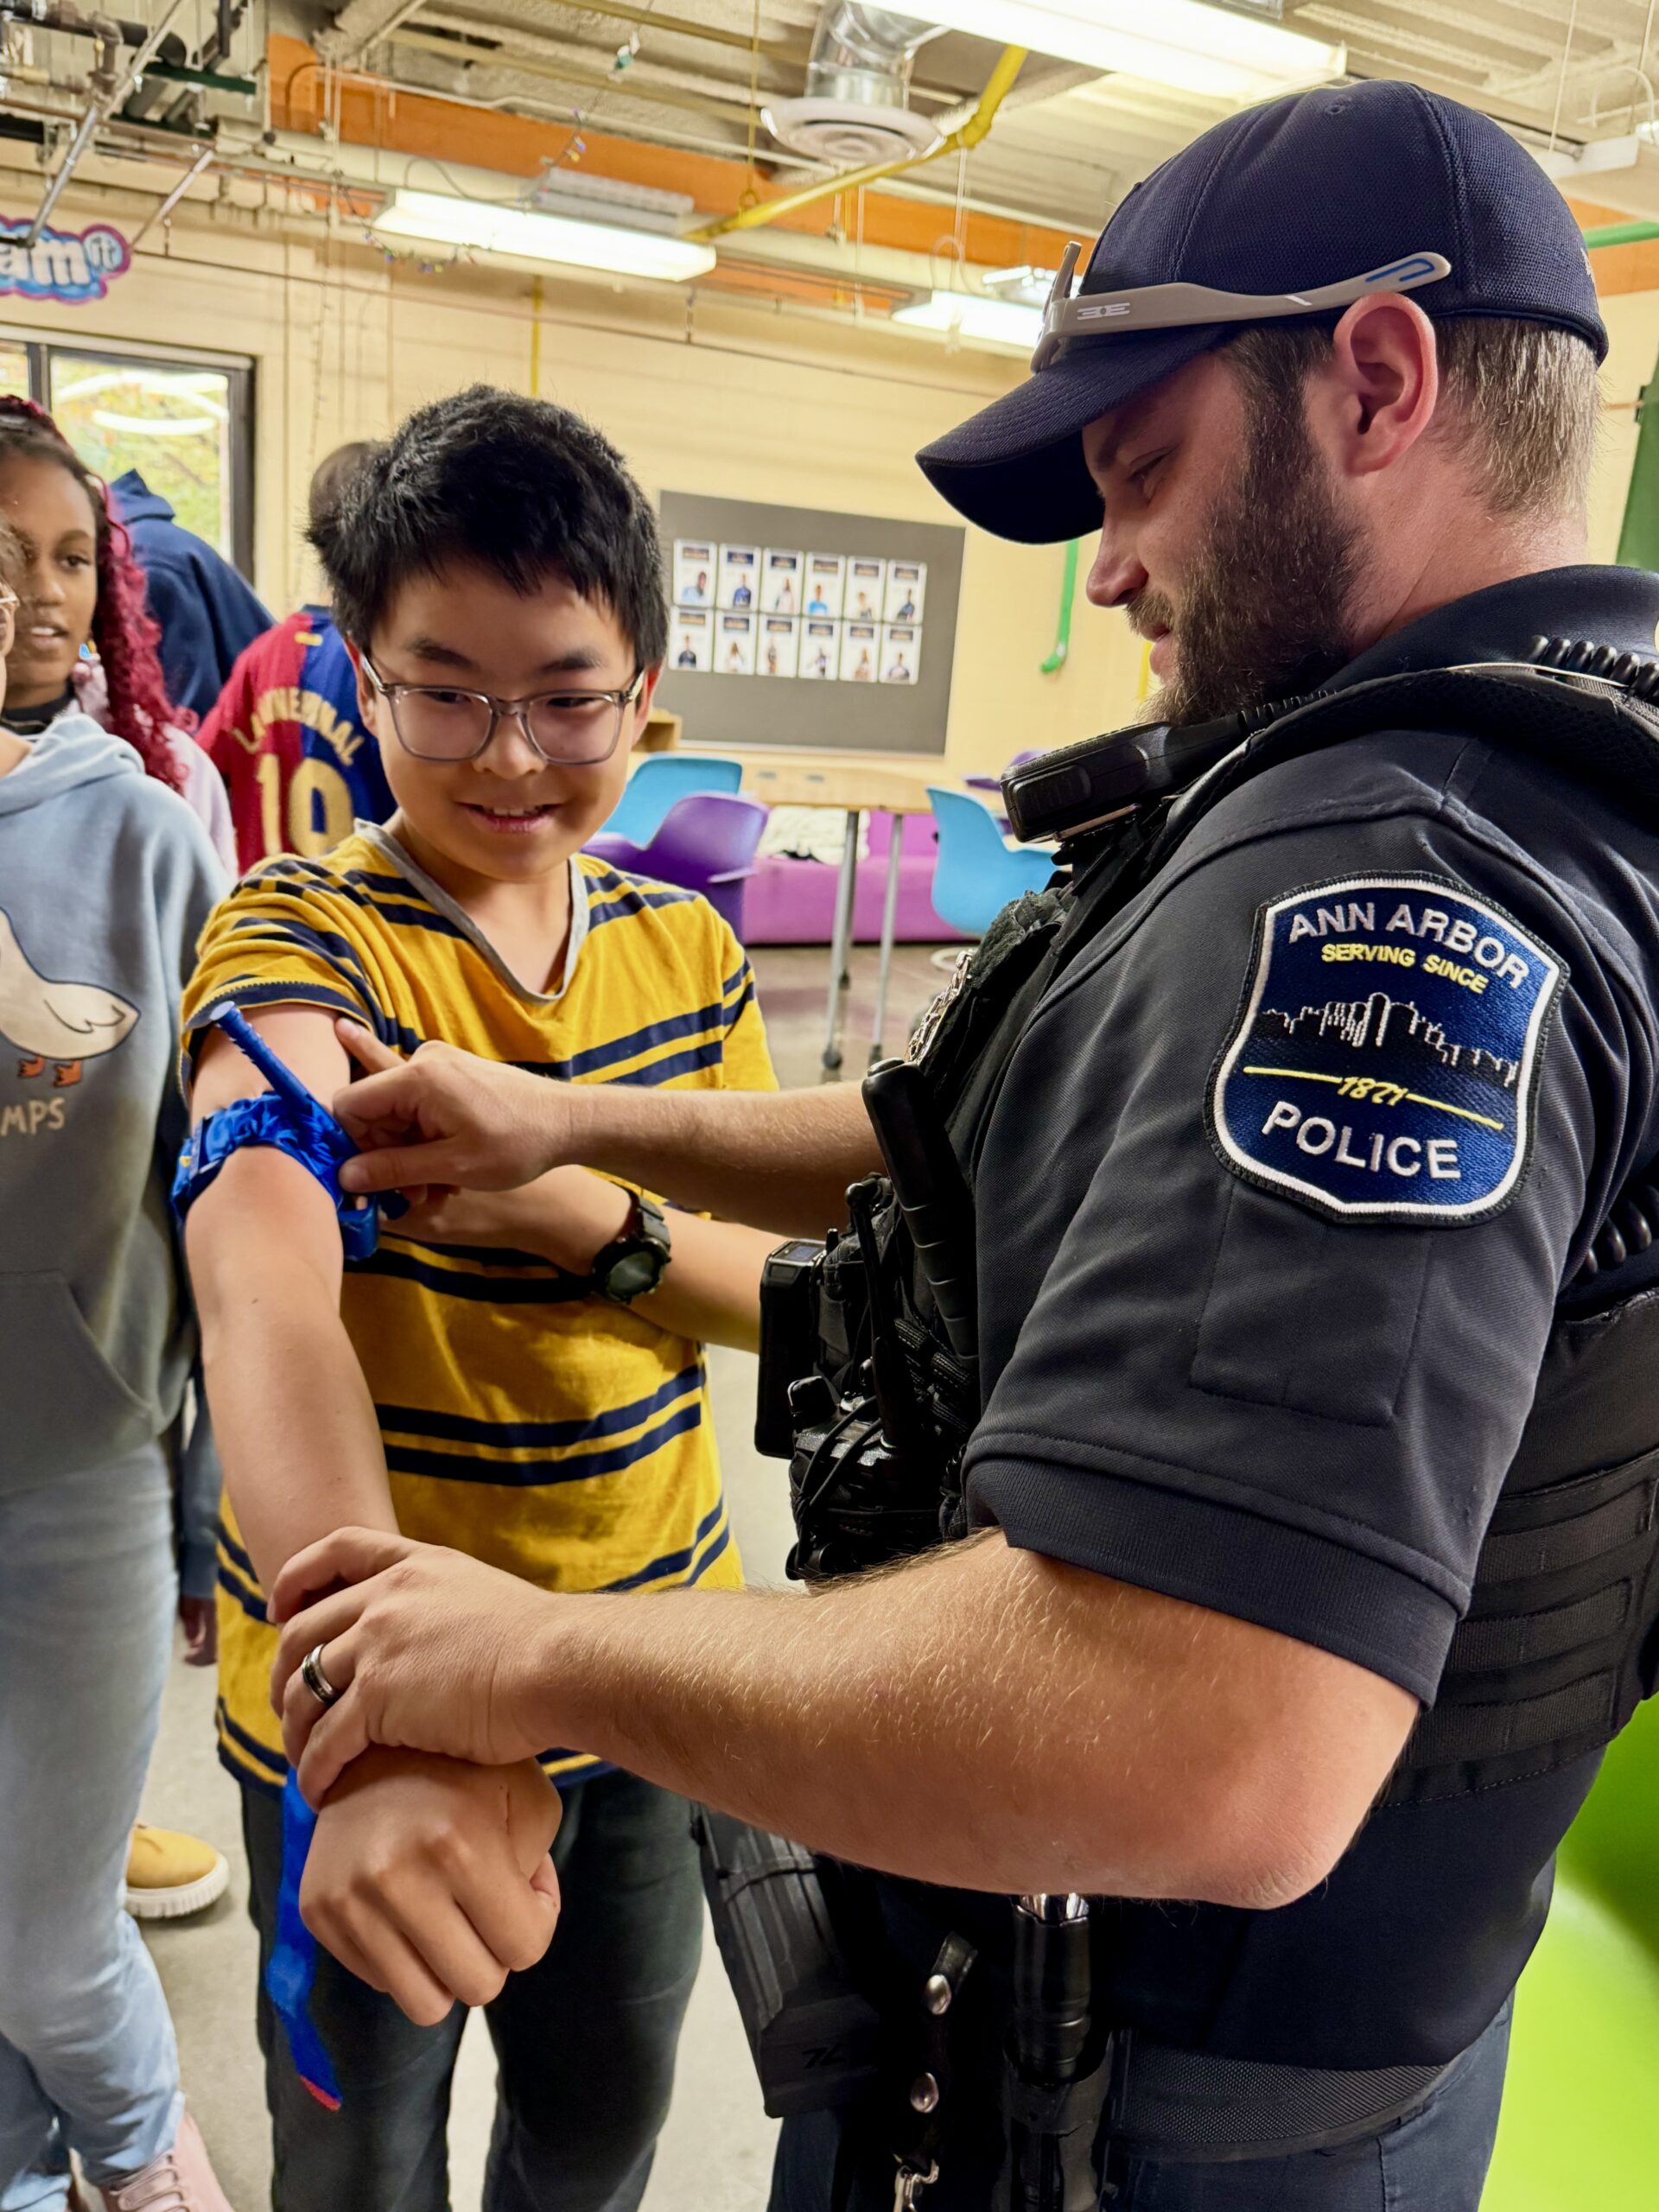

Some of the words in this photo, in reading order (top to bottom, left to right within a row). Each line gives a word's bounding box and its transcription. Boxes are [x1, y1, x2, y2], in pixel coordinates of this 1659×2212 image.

[256, 752, 355, 859] 10
[1287, 902, 1376, 944] ANN
[1386, 904, 1530, 988] ARBOR
[1321, 943, 1416, 967] SERVING
[1423, 954, 1488, 995] SINCE
[1336, 1077, 1410, 1106] 1871
[1262, 1101, 1462, 1179] POLICE
